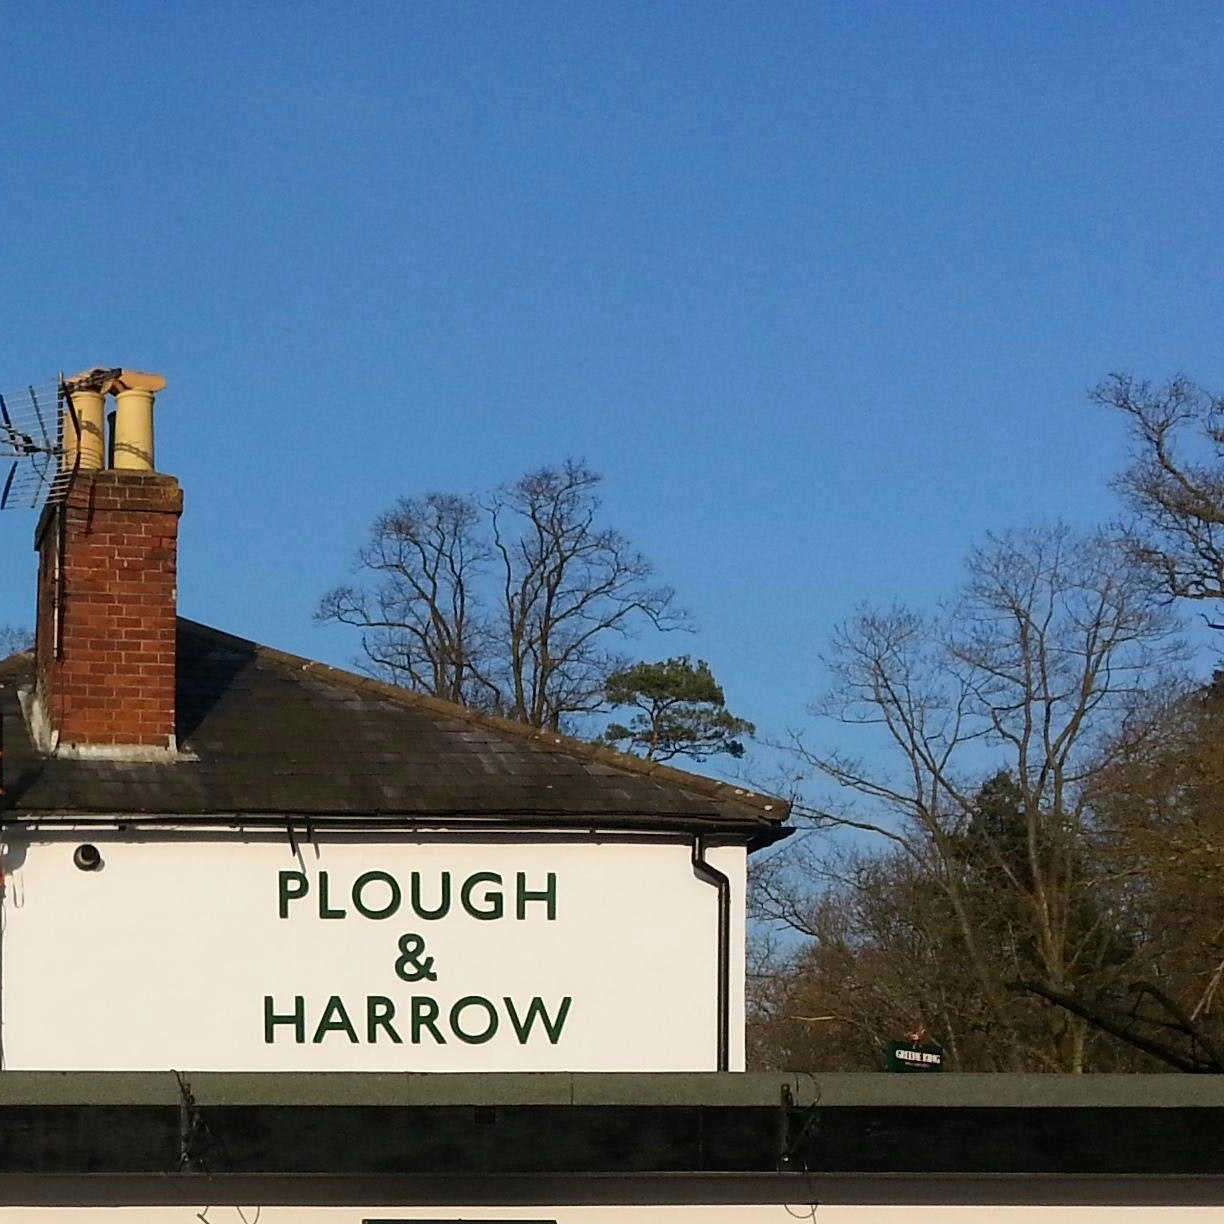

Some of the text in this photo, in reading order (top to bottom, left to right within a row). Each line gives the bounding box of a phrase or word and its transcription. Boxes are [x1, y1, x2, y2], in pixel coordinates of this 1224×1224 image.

[278, 870, 556, 921] PLOUGH
[394, 932, 438, 982] &
[264, 995, 572, 1045] HARROW
